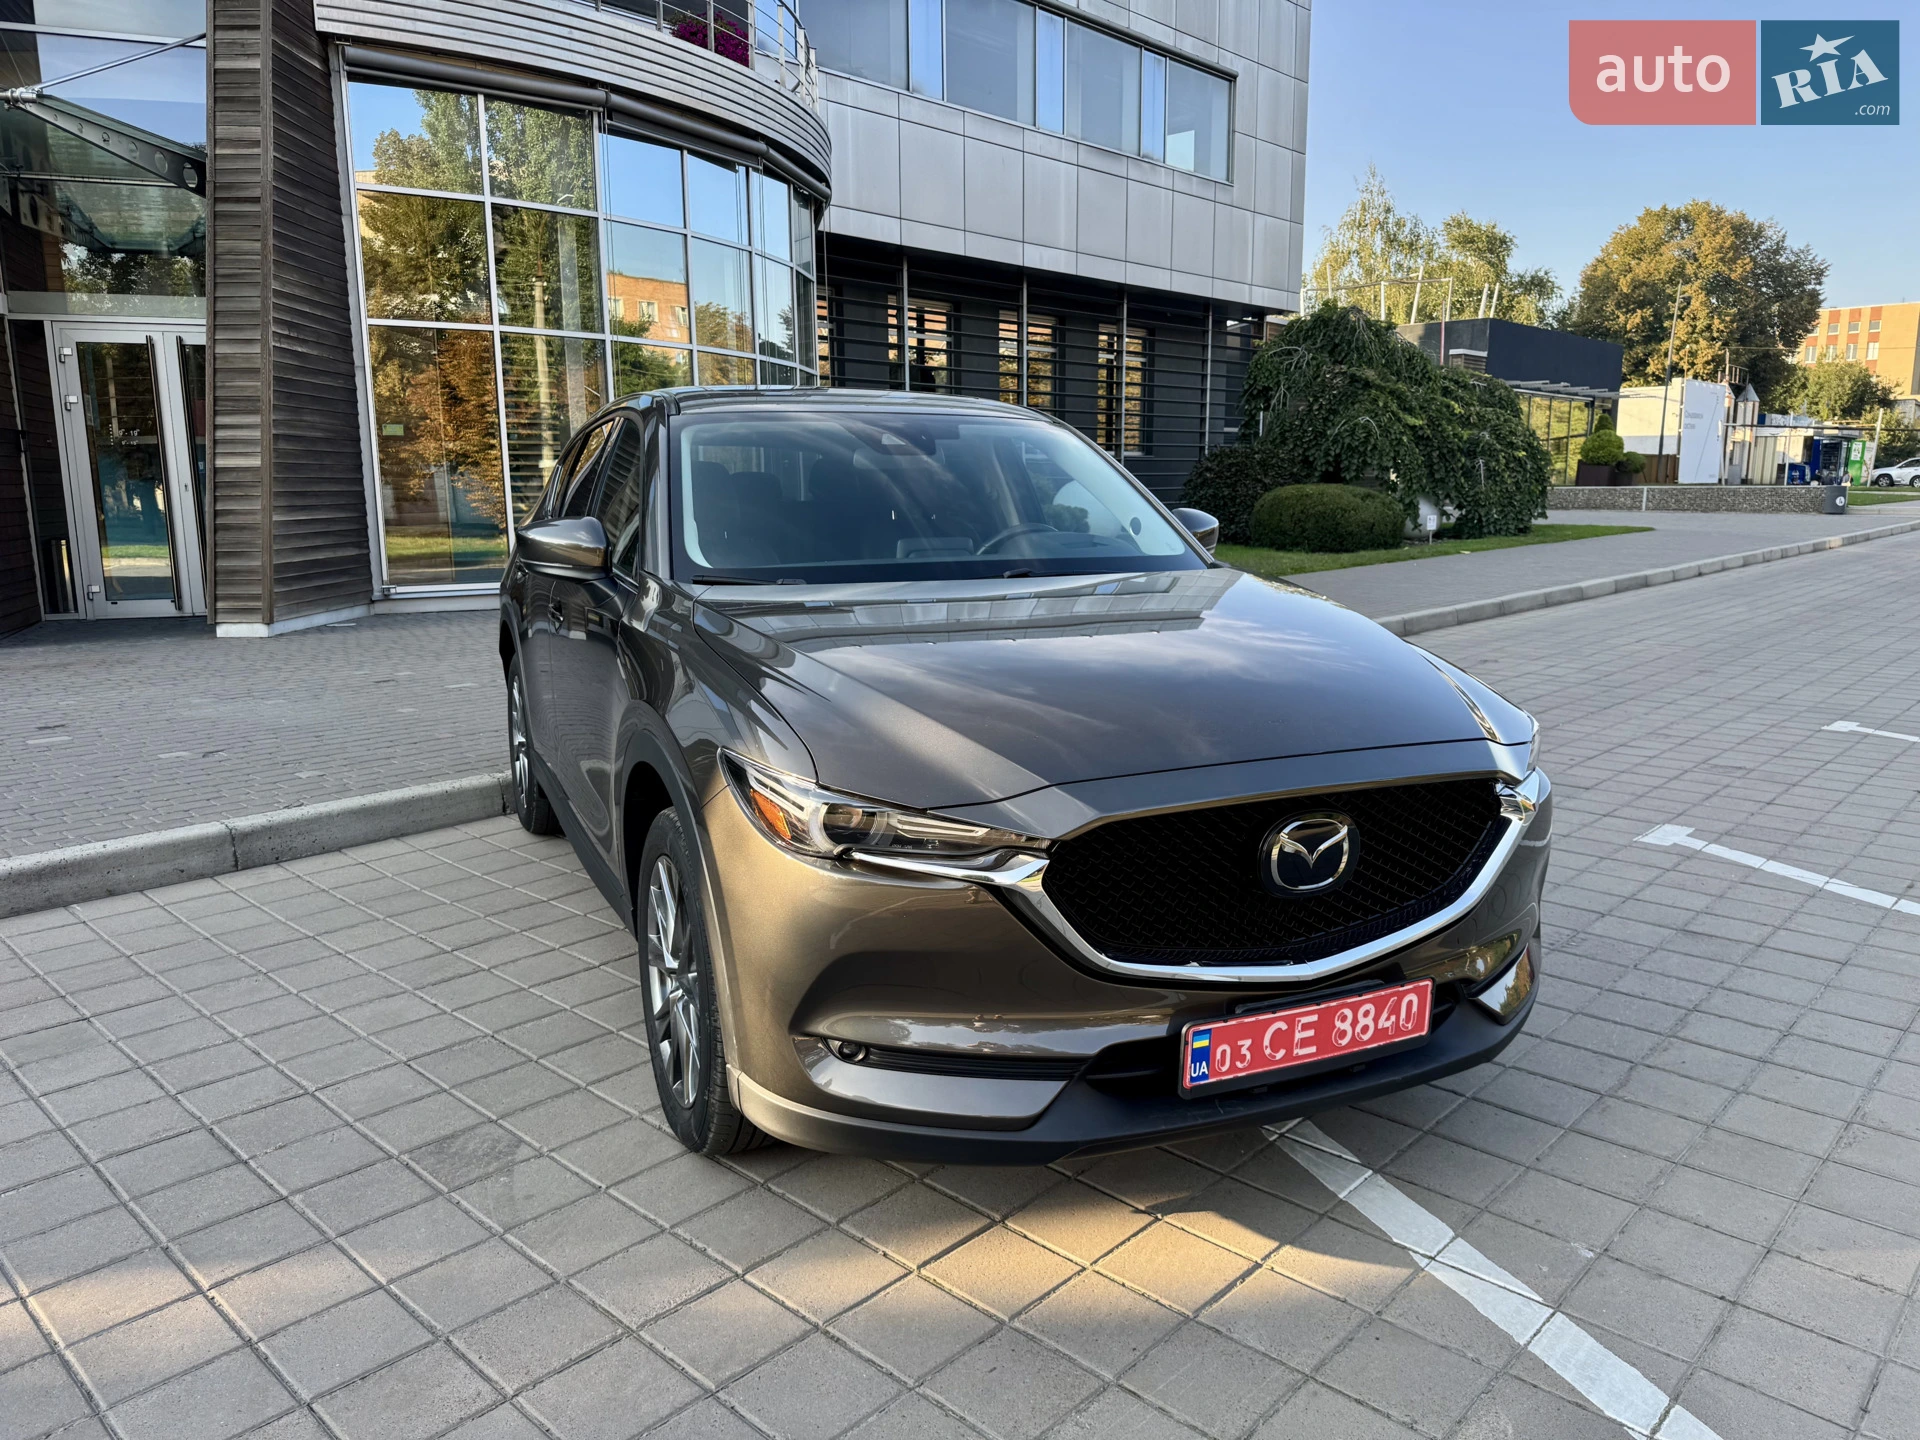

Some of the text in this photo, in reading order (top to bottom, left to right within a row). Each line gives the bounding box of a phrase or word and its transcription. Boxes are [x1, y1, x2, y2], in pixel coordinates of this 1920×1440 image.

[1215, 993, 1420, 1073] 03 CE 8840
[1190, 1063, 1209, 1078] UA
